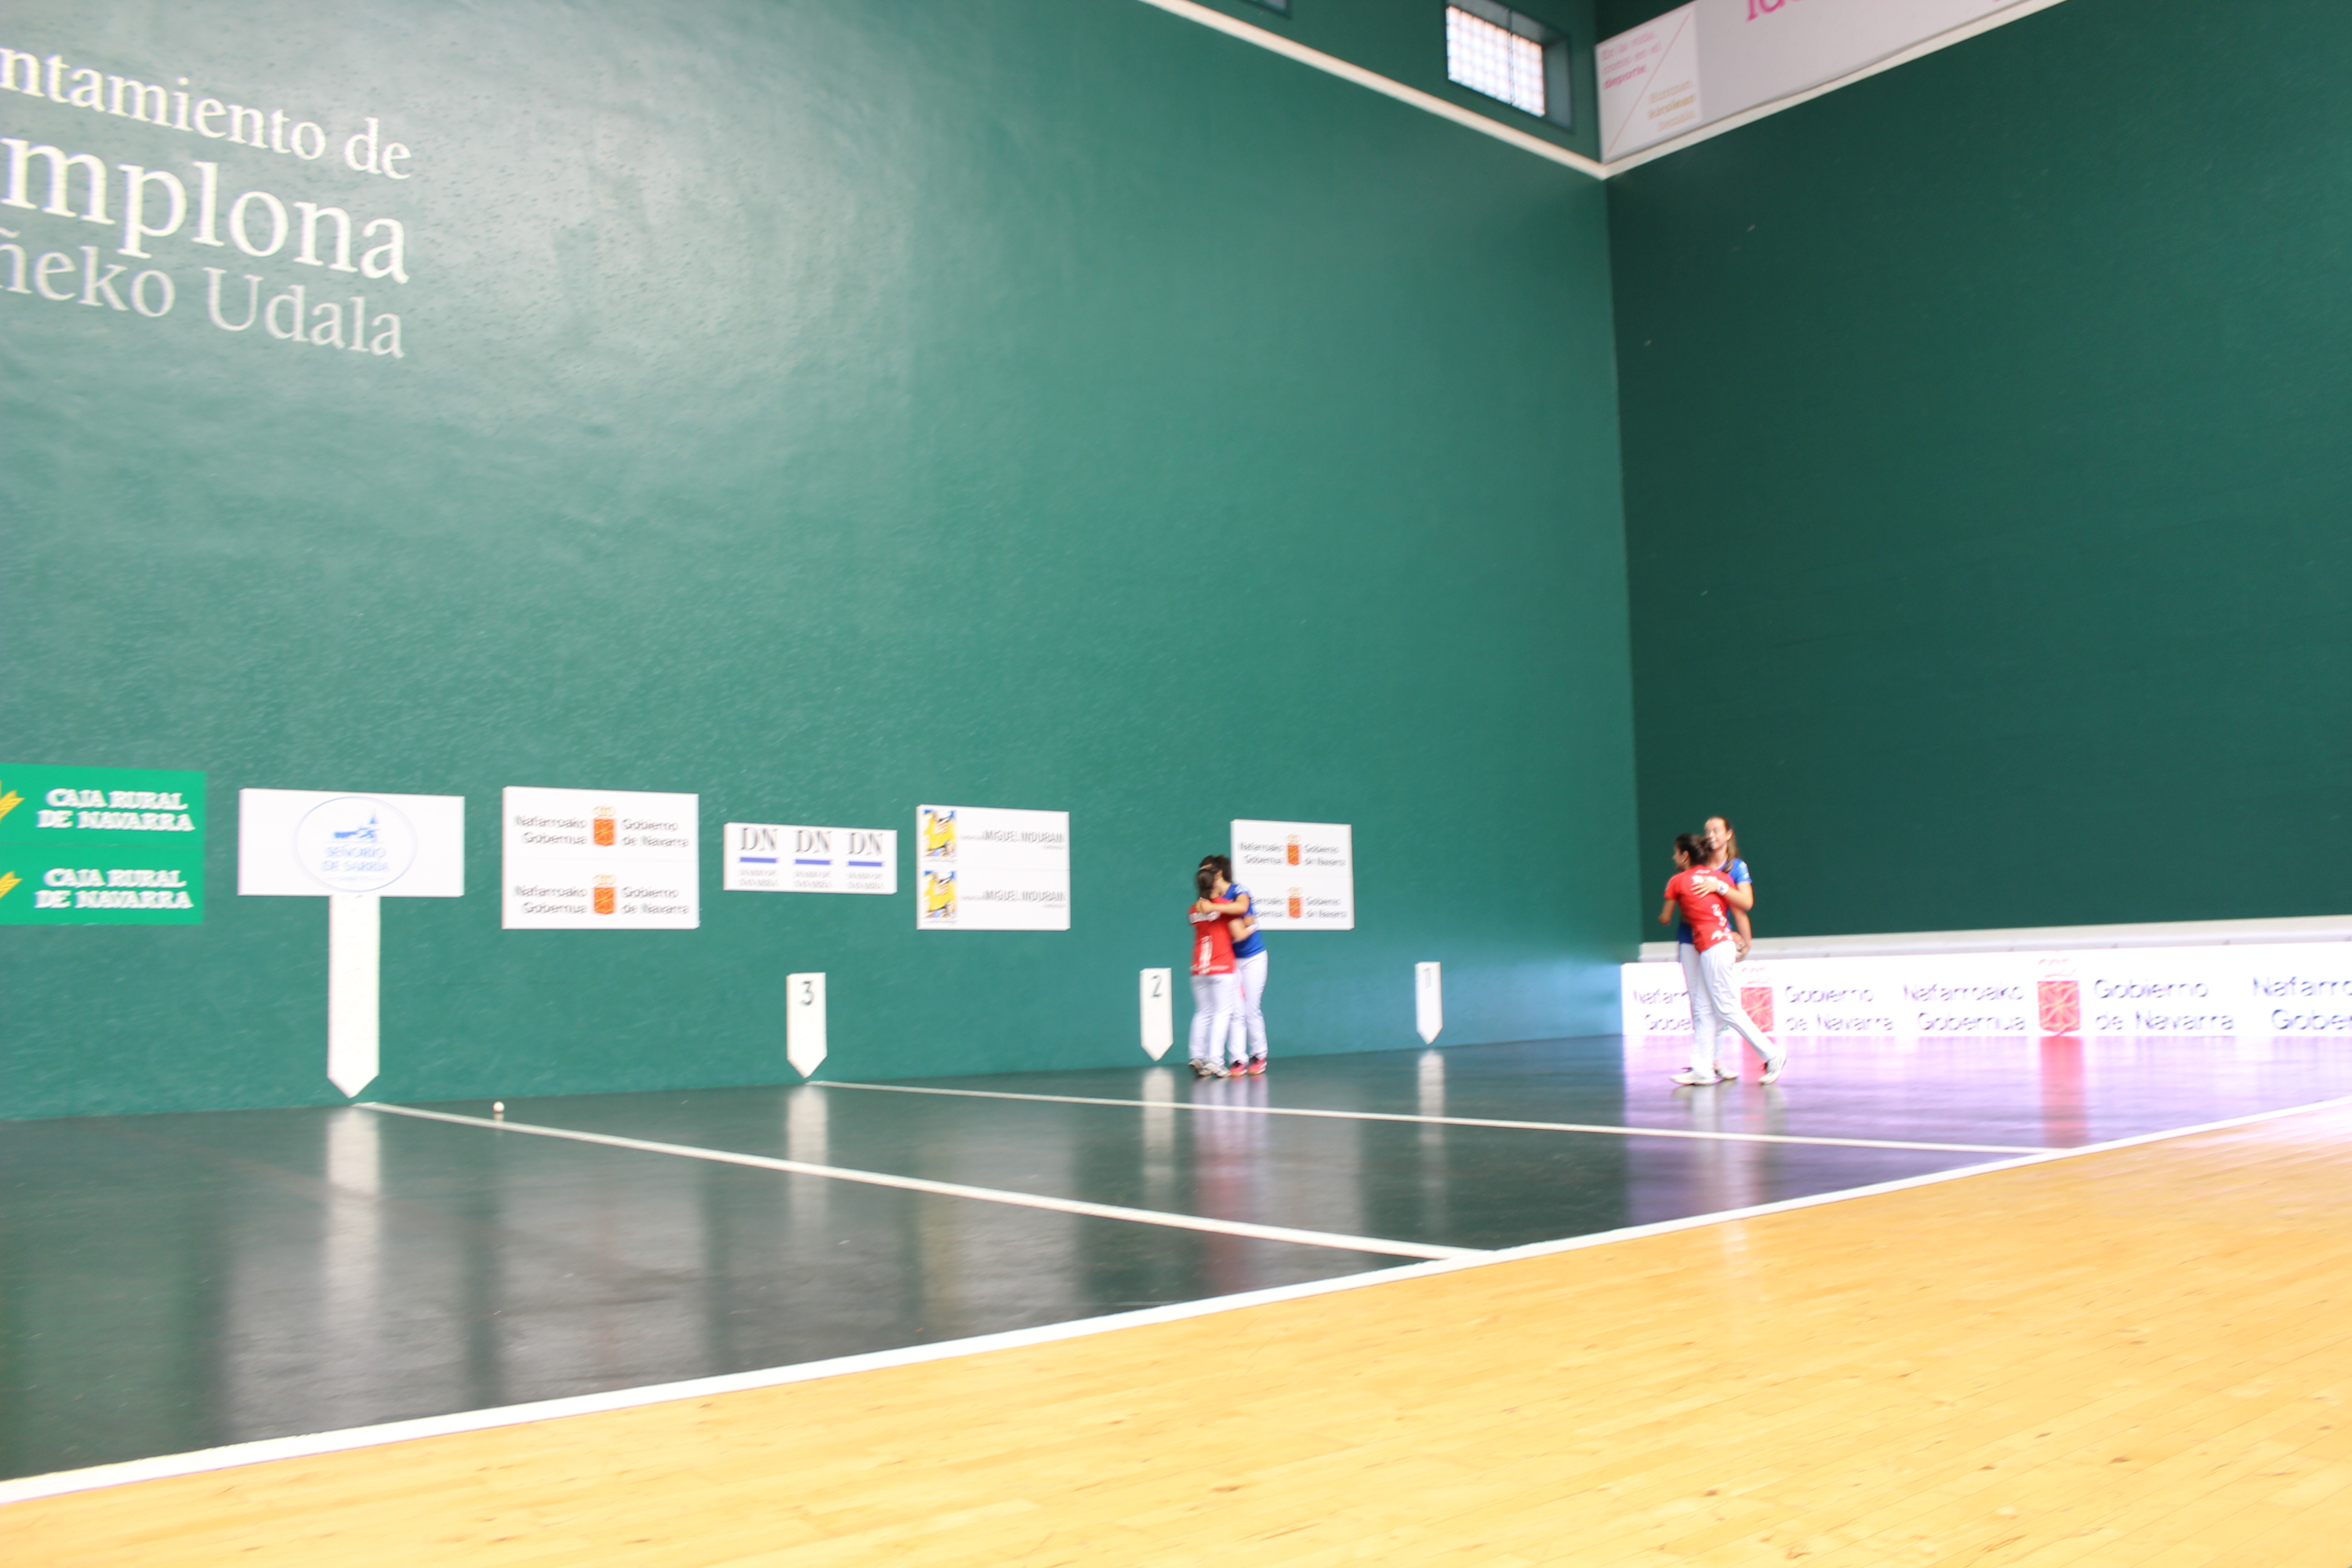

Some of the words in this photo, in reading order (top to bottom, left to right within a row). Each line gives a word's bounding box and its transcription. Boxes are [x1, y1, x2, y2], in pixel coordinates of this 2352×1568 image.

[1603, 64, 1647, 90] deporte
[0, 48, 326, 160] ntamiento
[345, 117, 412, 180] de
[202, 267, 405, 358] Udala
[45, 788, 107, 808] CAJA
[108, 790, 188, 811] RURAL
[36, 809, 74, 828] DE
[76, 811, 196, 832] NAVARRA
[513, 815, 588, 829] Nafarroako
[621, 818, 679, 831] Gobierno
[522, 832, 588, 845] Gobernua
[621, 835, 637, 846] de
[642, 836, 690, 848] Navarra
[739, 827, 779, 852] DN
[794, 830, 833, 854] DN
[847, 832, 886, 856] DN
[982, 829, 1020, 843] MIGUEL
[1021, 831, 1065, 843] INDURAIN
[1239, 841, 1284, 853] Nafarroako
[1303, 843, 1340, 854] Gobierno
[320, 860, 341, 872] DE
[1242, 854, 1285, 865] Gobernua
[1303, 857, 1316, 866] de
[1317, 857, 1347, 867] Navarra
[43, 868, 106, 888] CAJA
[106, 869, 187, 888] RURAL
[34, 890, 71, 909] DE
[74, 891, 194, 909] NAVARRA
[513, 885, 588, 898] Nafarroako
[621, 887, 679, 899] Gobierno
[982, 889, 1020, 902] MIGUEL
[1021, 890, 1065, 902] INDURAIN
[522, 902, 588, 915] Gobernua
[621, 903, 637, 915] de
[642, 903, 690, 915] Navarra
[1251, 897, 1286, 906] arroako
[1304, 896, 1342, 907] Gobierno
[1305, 909, 1318, 919] de
[1318, 909, 1349, 919] Navarra
[1150, 974, 1163, 998] 2
[1423, 966, 1431, 990] 1
[799, 980, 815, 1007] 3
[1784, 985, 1876, 1004] Gobierno
[1903, 982, 2025, 1001] Nafarroako
[2093, 979, 2209, 998] Gobierno
[1786, 1012, 1808, 1031] de
[1816, 1012, 1895, 1031] Navarra
[1917, 1012, 2026, 1031] Gobernua
[2095, 1010, 2124, 1031] de
[2135, 1010, 2234, 1031] Navarra
